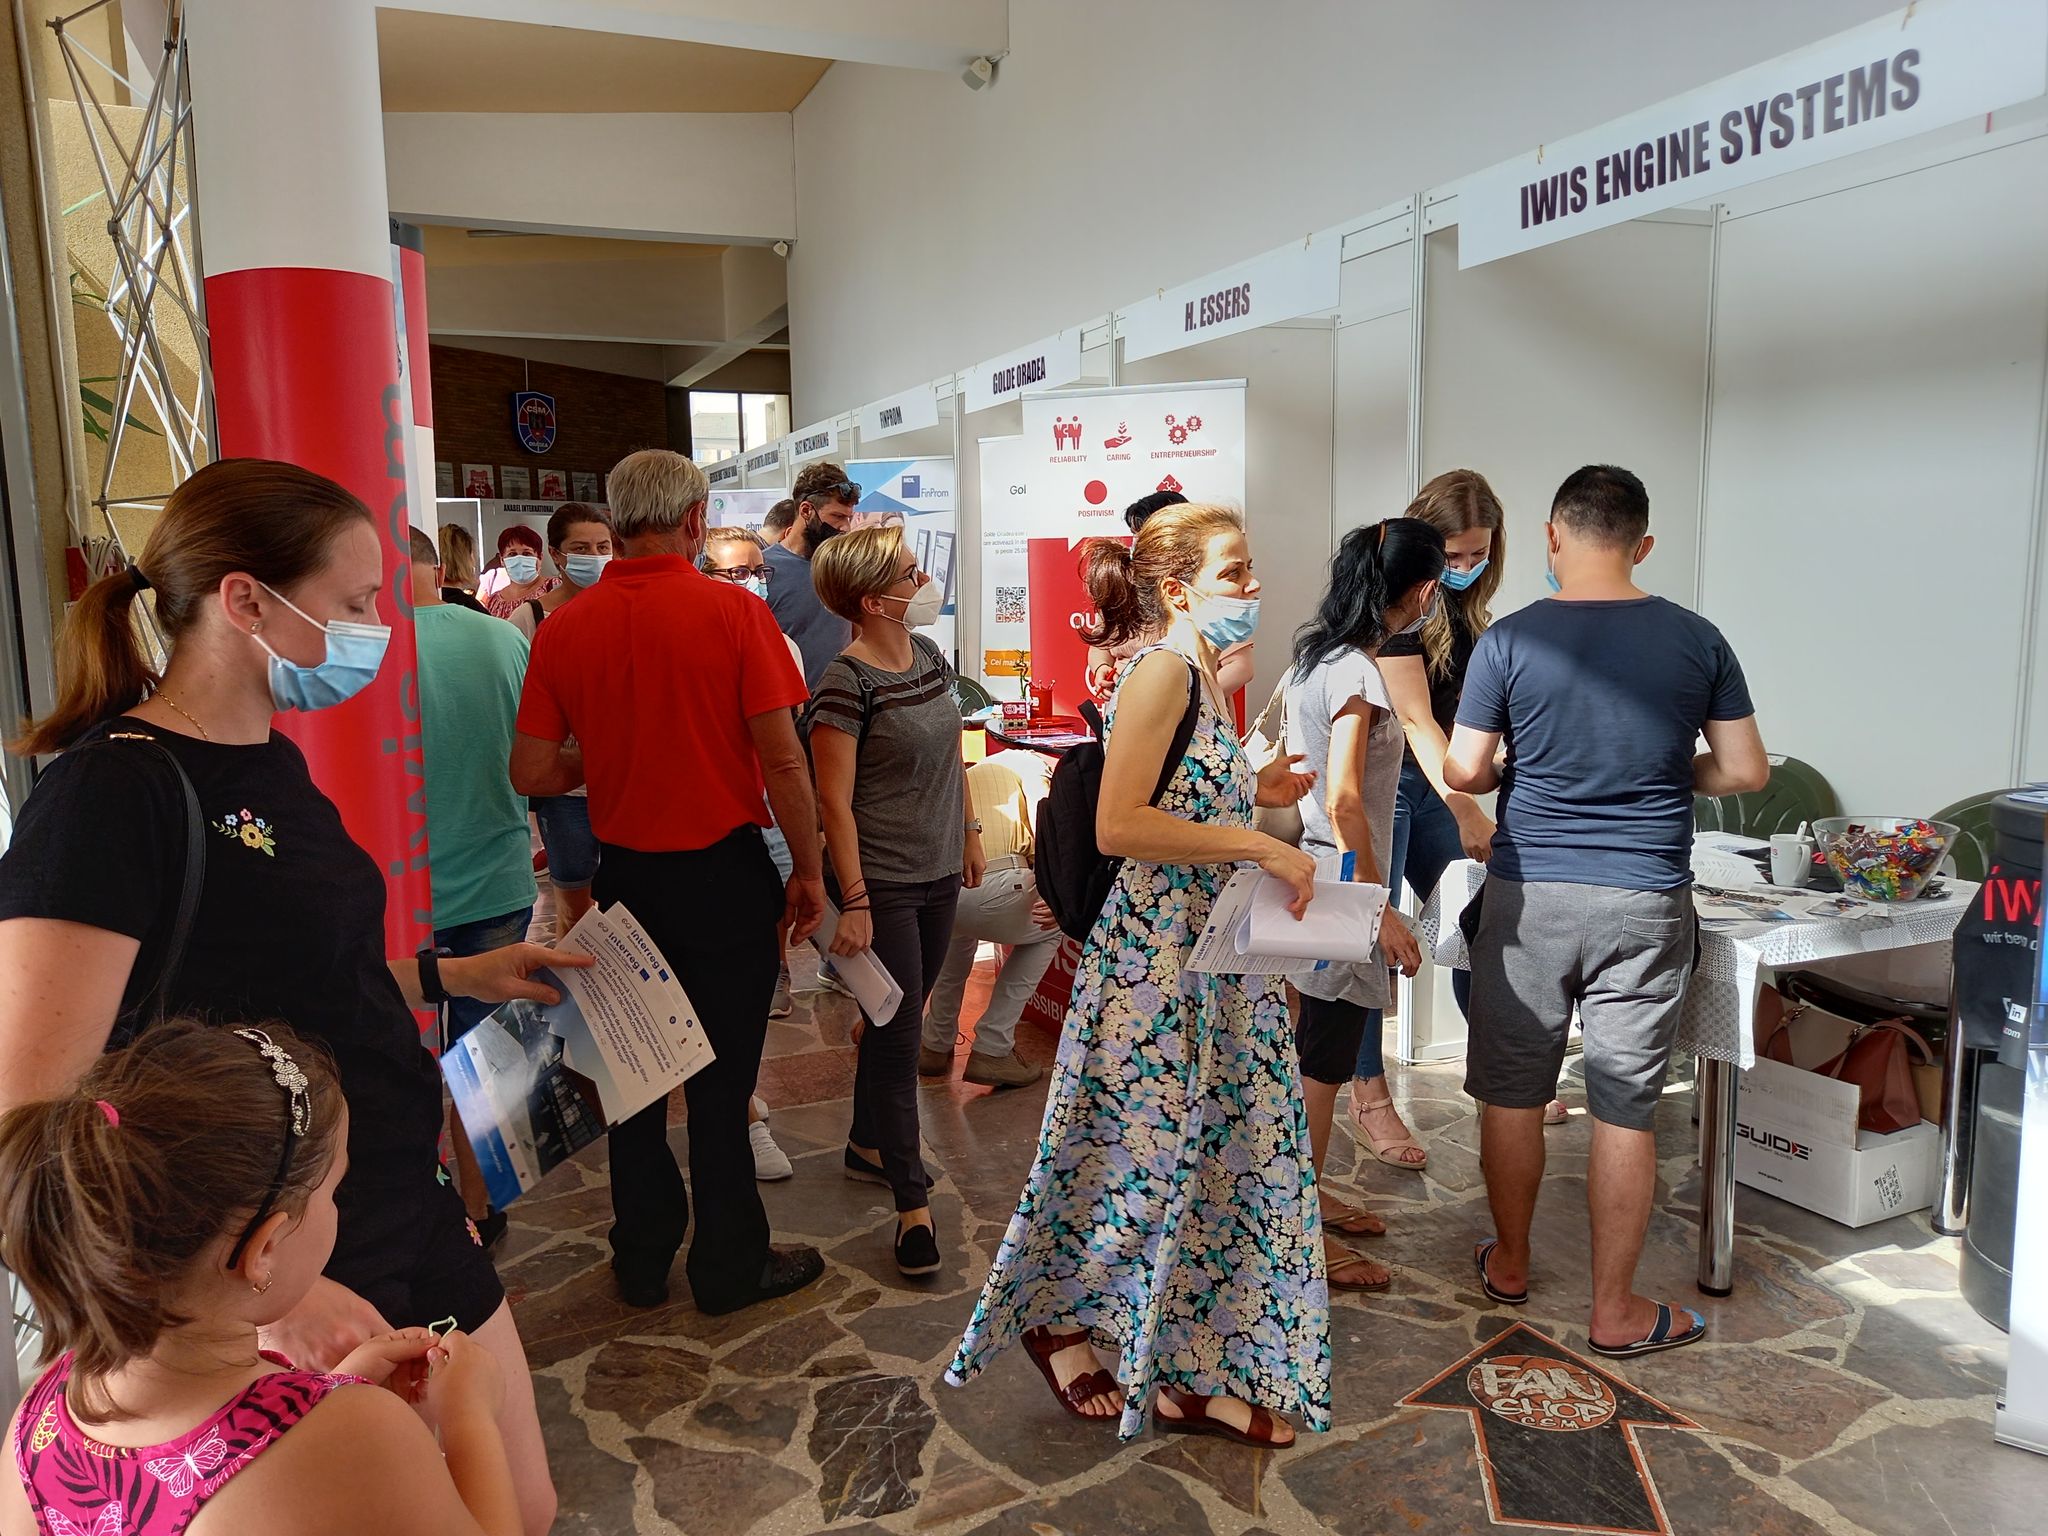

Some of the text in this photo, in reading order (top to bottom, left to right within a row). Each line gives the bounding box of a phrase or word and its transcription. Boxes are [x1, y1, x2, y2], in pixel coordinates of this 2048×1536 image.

[1520, 49, 1921, 229] IWIS ENGINE SYSTEMS
[1185, 283, 1251, 332] H. ESSERS
[993, 356, 1047, 395] GOLDE ORADEA
[526, 405, 546, 414] CSM
[1049, 449, 1217, 464] RELIABILITY CARING ENTREPRENEURSHIP
[474, 484, 486, 497] 55
[921, 487, 949, 498] FinProm
[1009, 484, 1027, 495] Gol
[1078, 509, 1115, 517] POSITIVISM
[746, 521, 763, 531] ebm
[1983, 933, 2002, 944] wir
[606, 931, 641, 970] Interreg
[629, 928, 661, 970] Interreg
[2010, 1007, 2021, 1019] in
[1480, 1358, 1606, 1401] FAN
[1490, 1398, 1616, 1423] SHOP
